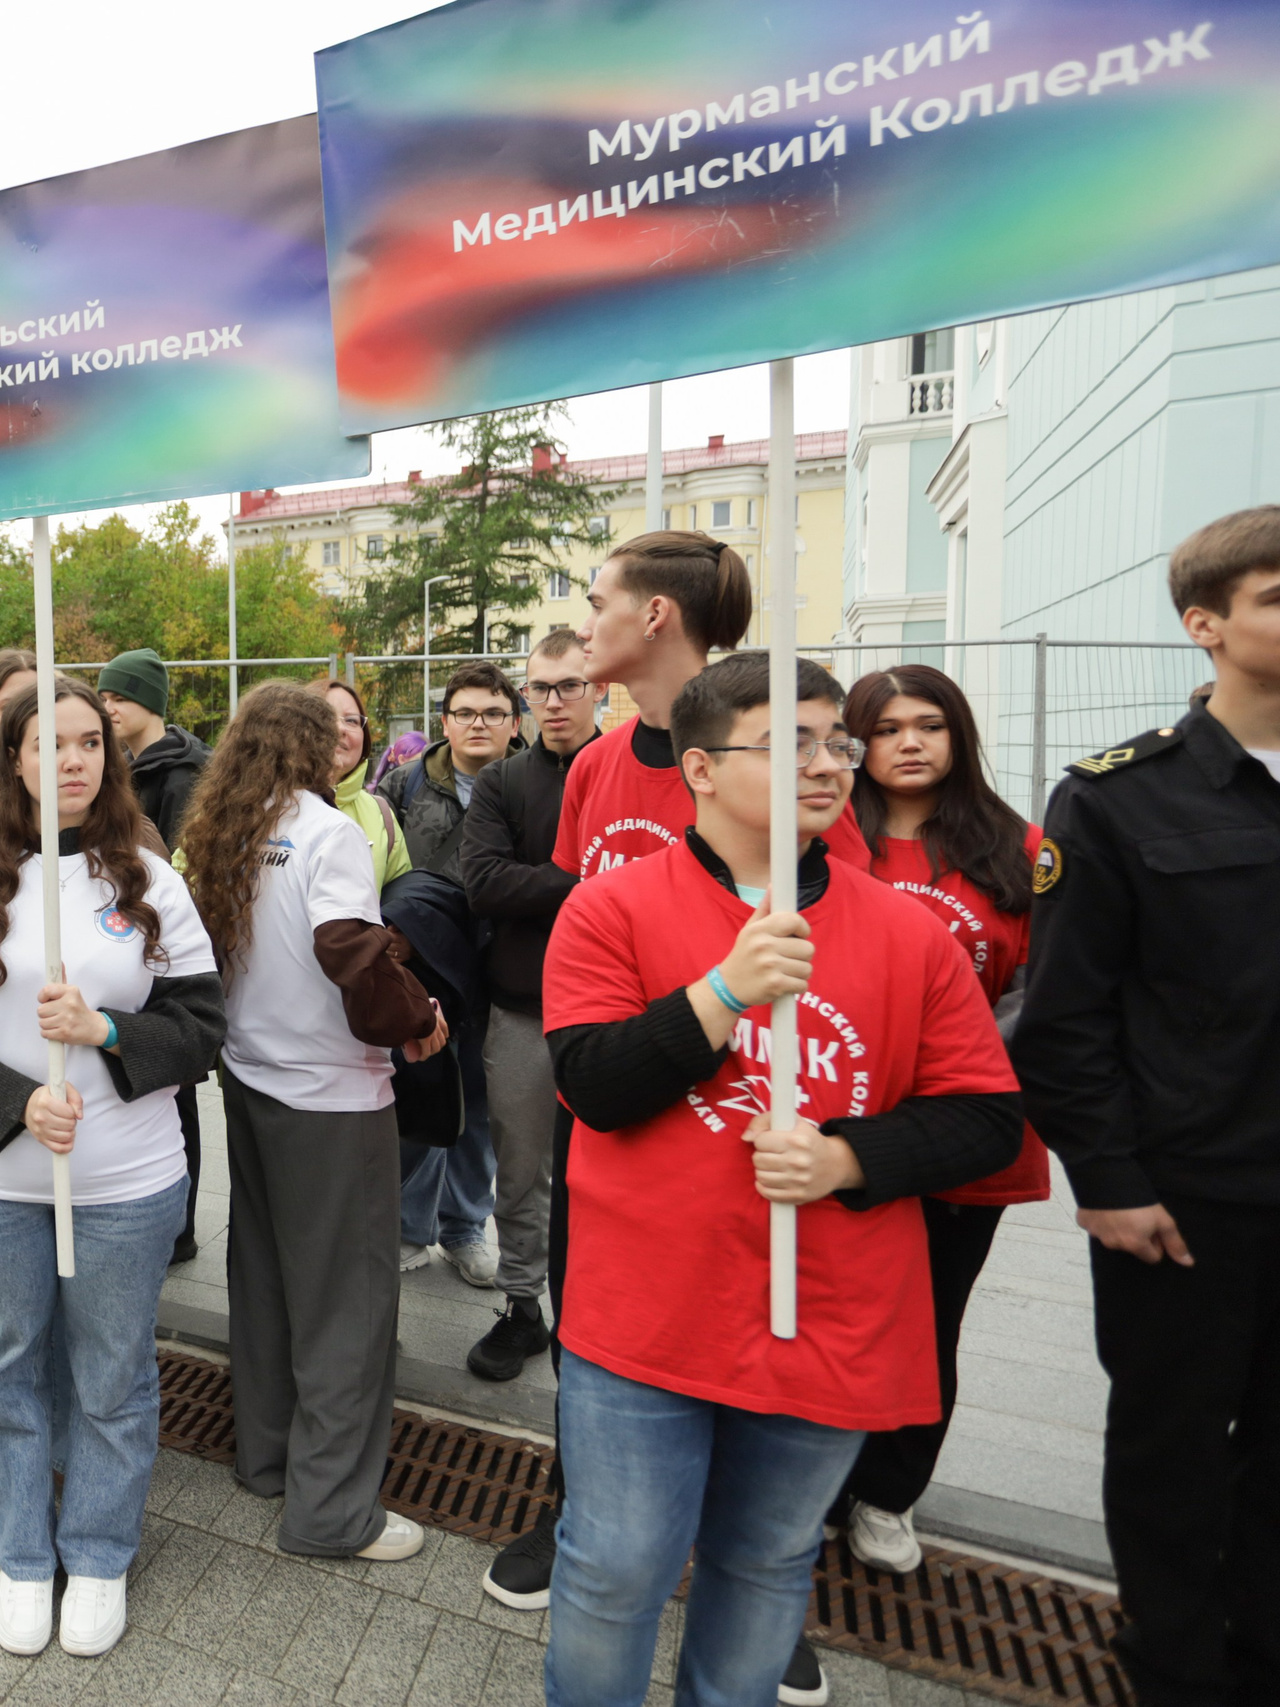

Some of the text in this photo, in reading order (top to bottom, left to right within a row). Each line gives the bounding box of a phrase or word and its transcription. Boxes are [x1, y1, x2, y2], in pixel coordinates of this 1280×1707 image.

[588, 10, 991, 165] Мурманский
[452, 22, 1215, 253] Медицинский Колледж
[71, 323, 244, 376] колледж
[580, 835, 603, 882] СКИЙ
[892, 881, 984, 933] ИЦИНСКИЙ
[794, 991, 867, 1060] НСКИЙ
[847, 1071, 869, 1117] КОЛ
